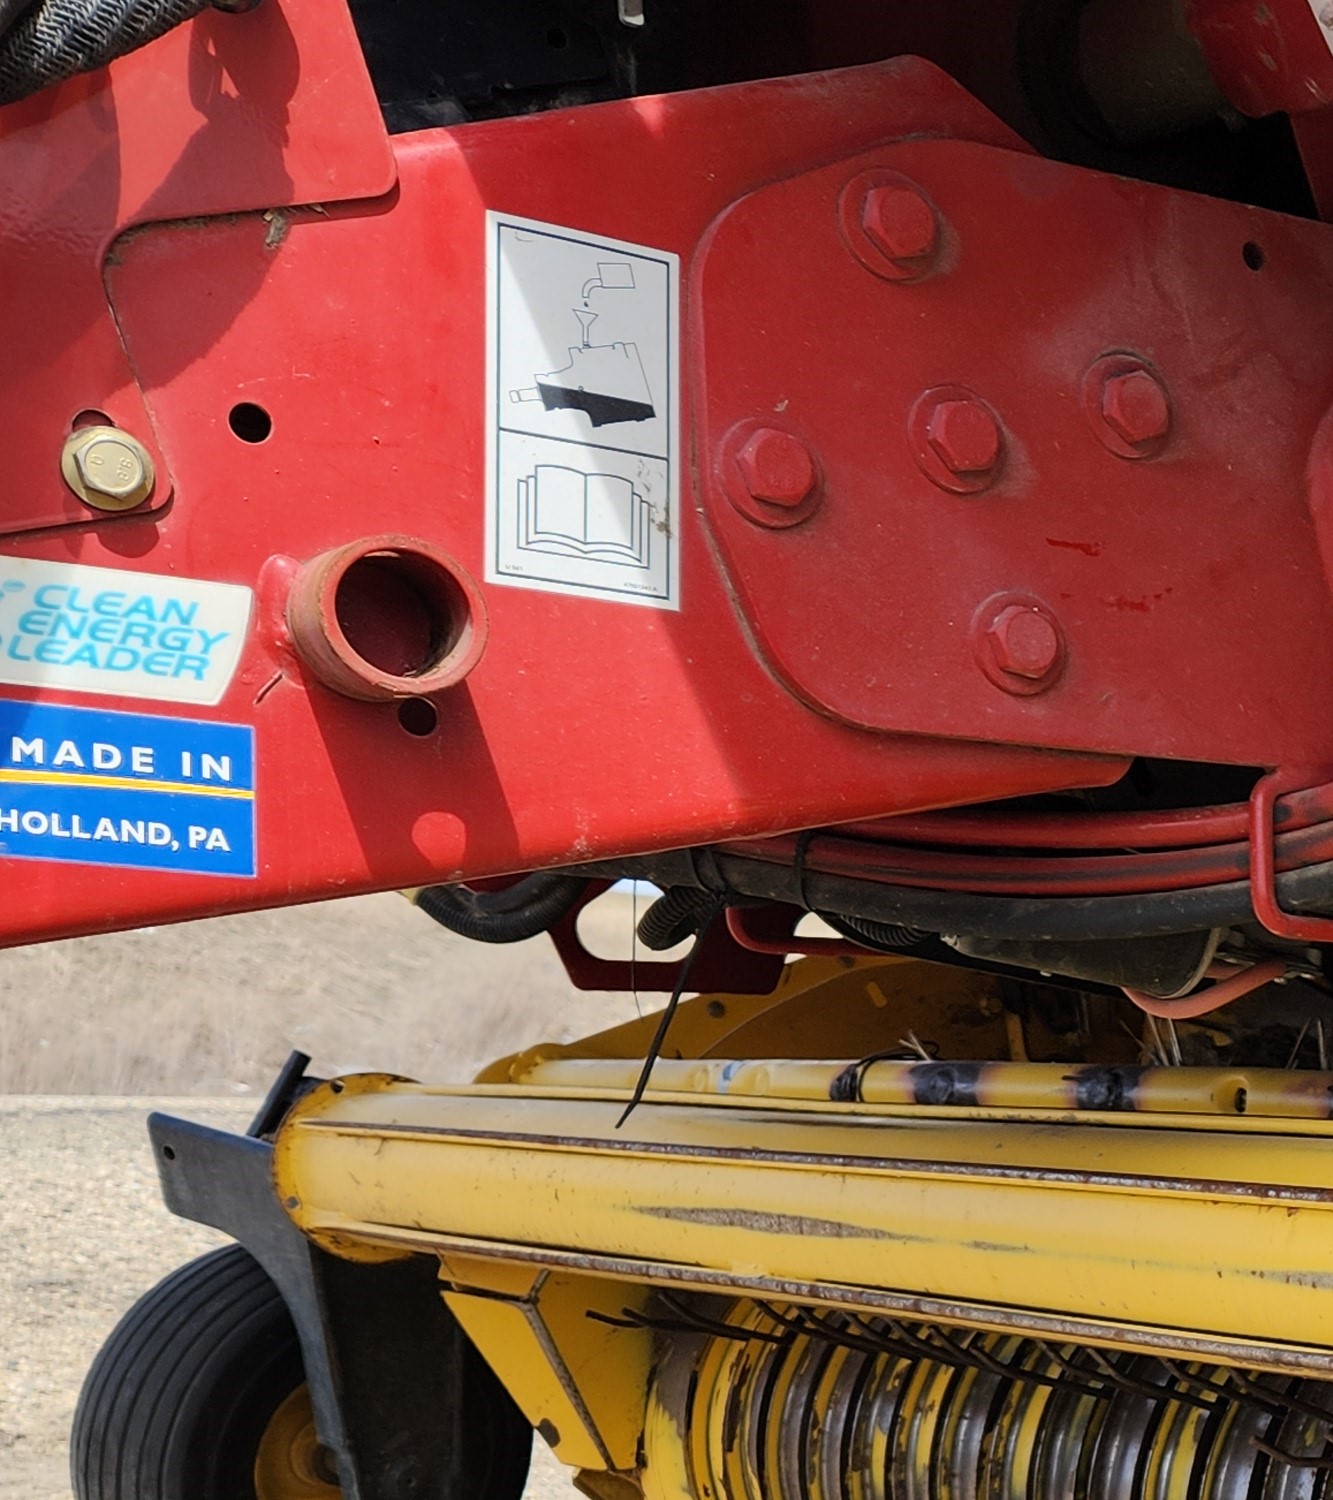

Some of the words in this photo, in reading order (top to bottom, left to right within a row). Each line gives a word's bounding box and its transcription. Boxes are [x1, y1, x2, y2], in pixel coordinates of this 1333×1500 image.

[33, 583, 199, 625] CLEAN
[18, 609, 231, 655] ENERGY
[7, 635, 210, 680] LEADER
[11, 736, 154, 773] MADE
[182, 751, 231, 781] IN
[0, 807, 180, 851] HOLLAND,
[188, 825, 232, 852] PA
